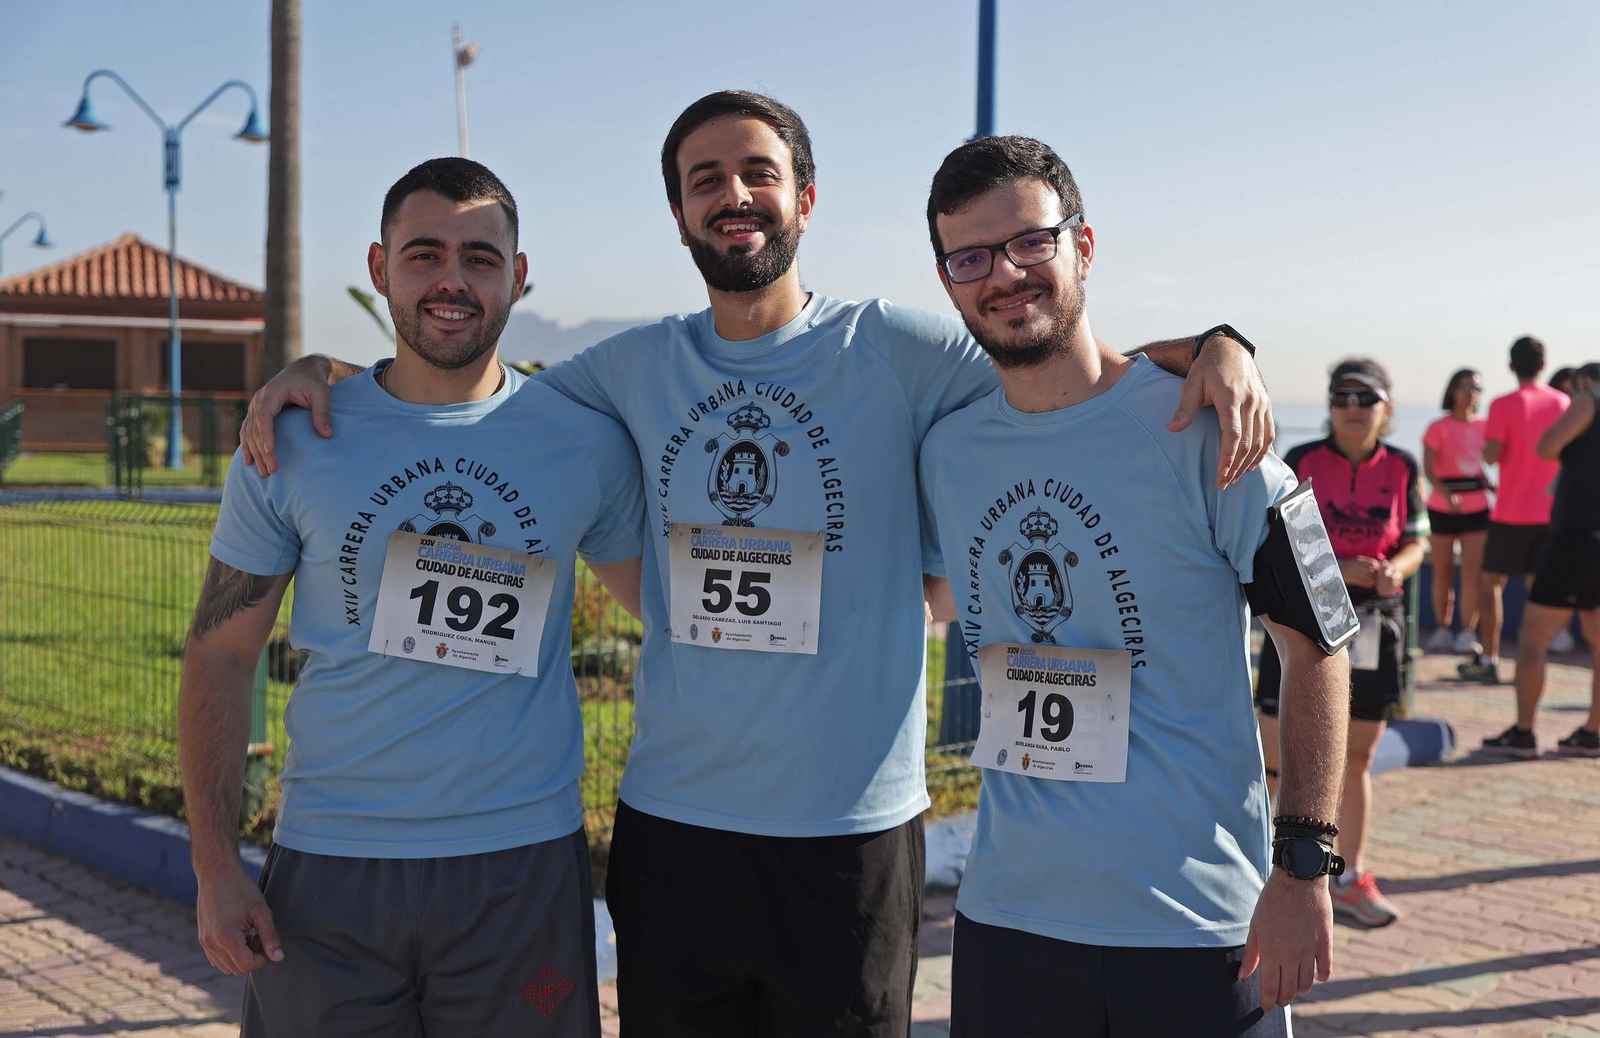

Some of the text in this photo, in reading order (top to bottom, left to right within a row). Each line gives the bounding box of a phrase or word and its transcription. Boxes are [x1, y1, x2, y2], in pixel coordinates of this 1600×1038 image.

[688, 379, 747, 422] URBANA
[755, 382, 814, 424] CIUDAD
[807, 425, 830, 450] DE
[658, 426, 694, 498] CARRERA
[817, 457, 845, 553] ALGECIRAS
[339, 456, 537, 626] XXIV CARRERA URBANA CIUDAD DE
[420, 538, 461, 552] XXIV EDICIÓN
[690, 536, 792, 553] CARRERA URBANA
[691, 547, 792, 566] CIUDAD DE ALGECIRAS
[416, 558, 524, 589] CIUDAD DE ALGECIRAS
[417, 546, 526, 576] CARRERA URBANA
[967, 536, 986, 615] CARRERA
[980, 478, 1036, 531] URBANA
[1044, 478, 1101, 529] CIUDAD
[1093, 532, 1119, 560] DE
[1106, 569, 1147, 669] ALGECIRAS
[409, 579, 520, 640] 192
[702, 568, 771, 617] 55
[421, 629, 497, 646] RODRÍGUEZ COCA, MANUEL
[1006, 655, 1097, 673] CARRERA URBANA
[1006, 668, 1097, 687] CIUDAD DE ALGECIRAS
[1018, 690, 1074, 743] 19
